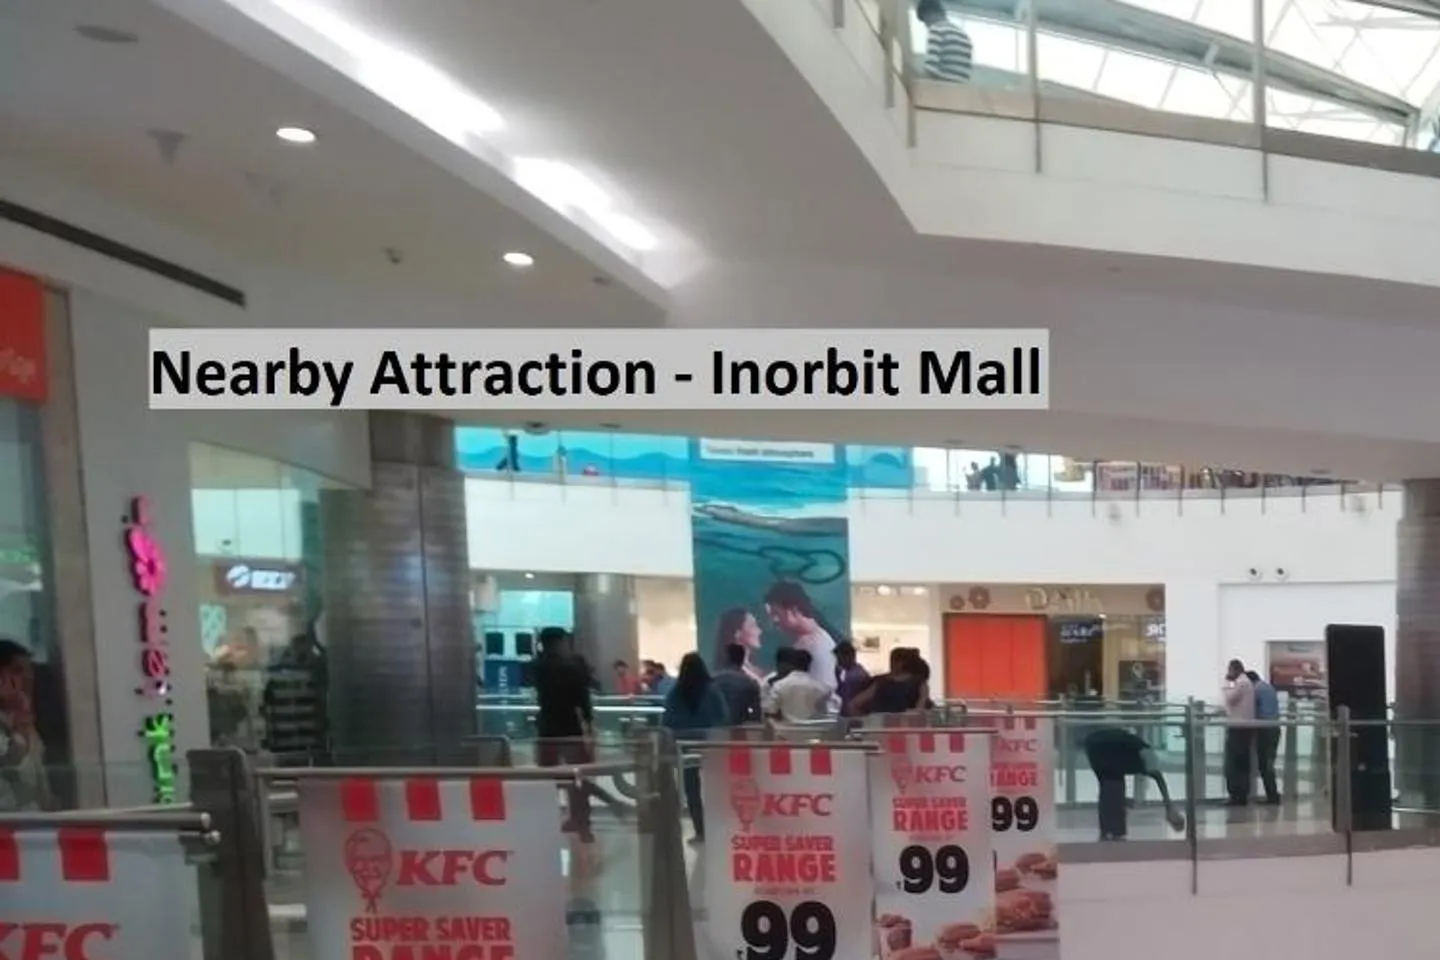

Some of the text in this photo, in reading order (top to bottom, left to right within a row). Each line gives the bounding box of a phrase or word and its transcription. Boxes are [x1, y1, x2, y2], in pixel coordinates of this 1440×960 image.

[915, 765, 967, 784] KFC
[761, 793, 835, 817] KFC
[990, 796, 1039, 832] 99
[892, 808, 969, 833] RANGE
[731, 835, 835, 852] SUPER SAVER
[395, 850, 515, 886] KFC
[732, 852, 837, 884] RANGE
[350, 917, 511, 942] SUPER SAVER
